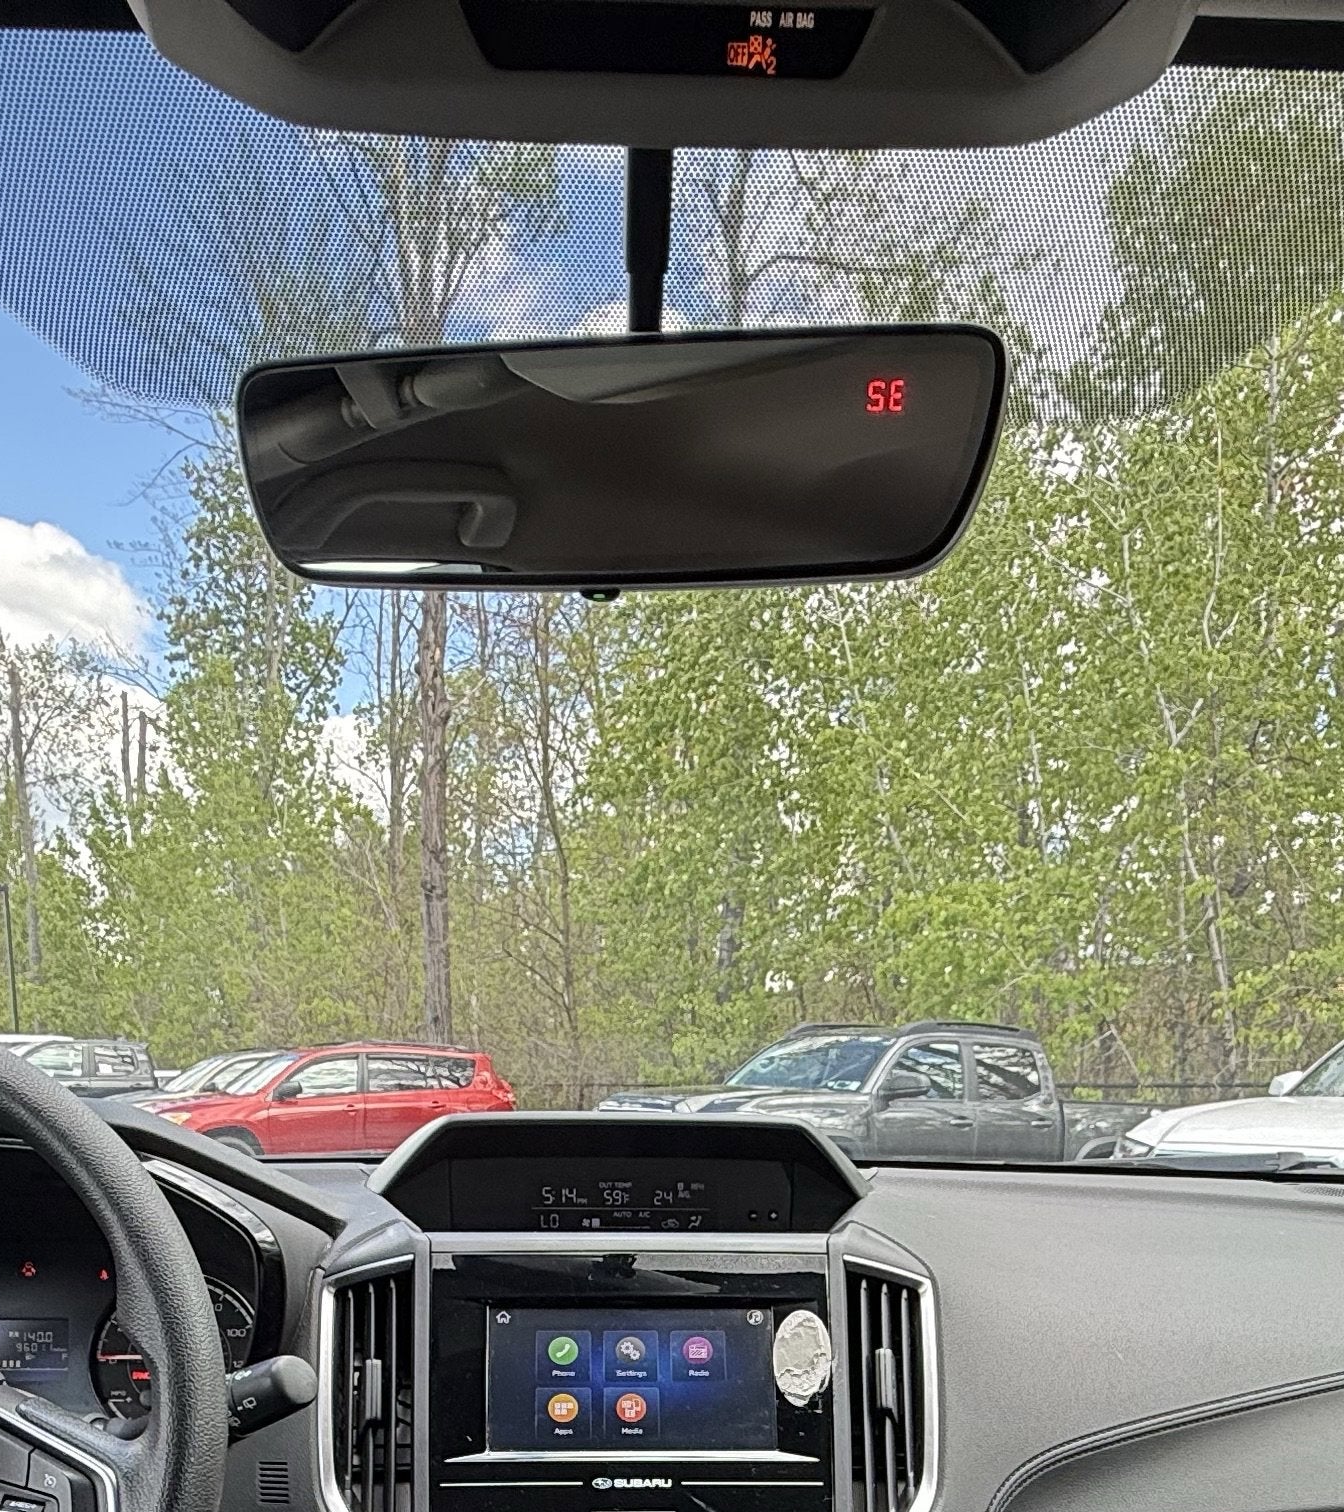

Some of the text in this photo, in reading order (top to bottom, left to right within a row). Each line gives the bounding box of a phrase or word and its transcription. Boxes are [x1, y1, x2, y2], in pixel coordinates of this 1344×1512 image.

[749, 11, 815, 28] PASS AIR BAG
[728, 43, 747, 65] OFF
[866, 379, 905, 412] SE
[542, 1186, 577, 1204] 5:14
[653, 1190, 673, 1206] 24
[540, 1214, 560, 1228] LO
[226, 1328, 247, 1338] 100
[552, 1369, 576, 1377] Phone
[616, 1369, 648, 1378] Settings
[688, 1369, 710, 1377] Radio
[554, 1427, 574, 1436] Apps
[621, 1427, 643, 1435] Media
[613, 1478, 673, 1488] SUBARU
